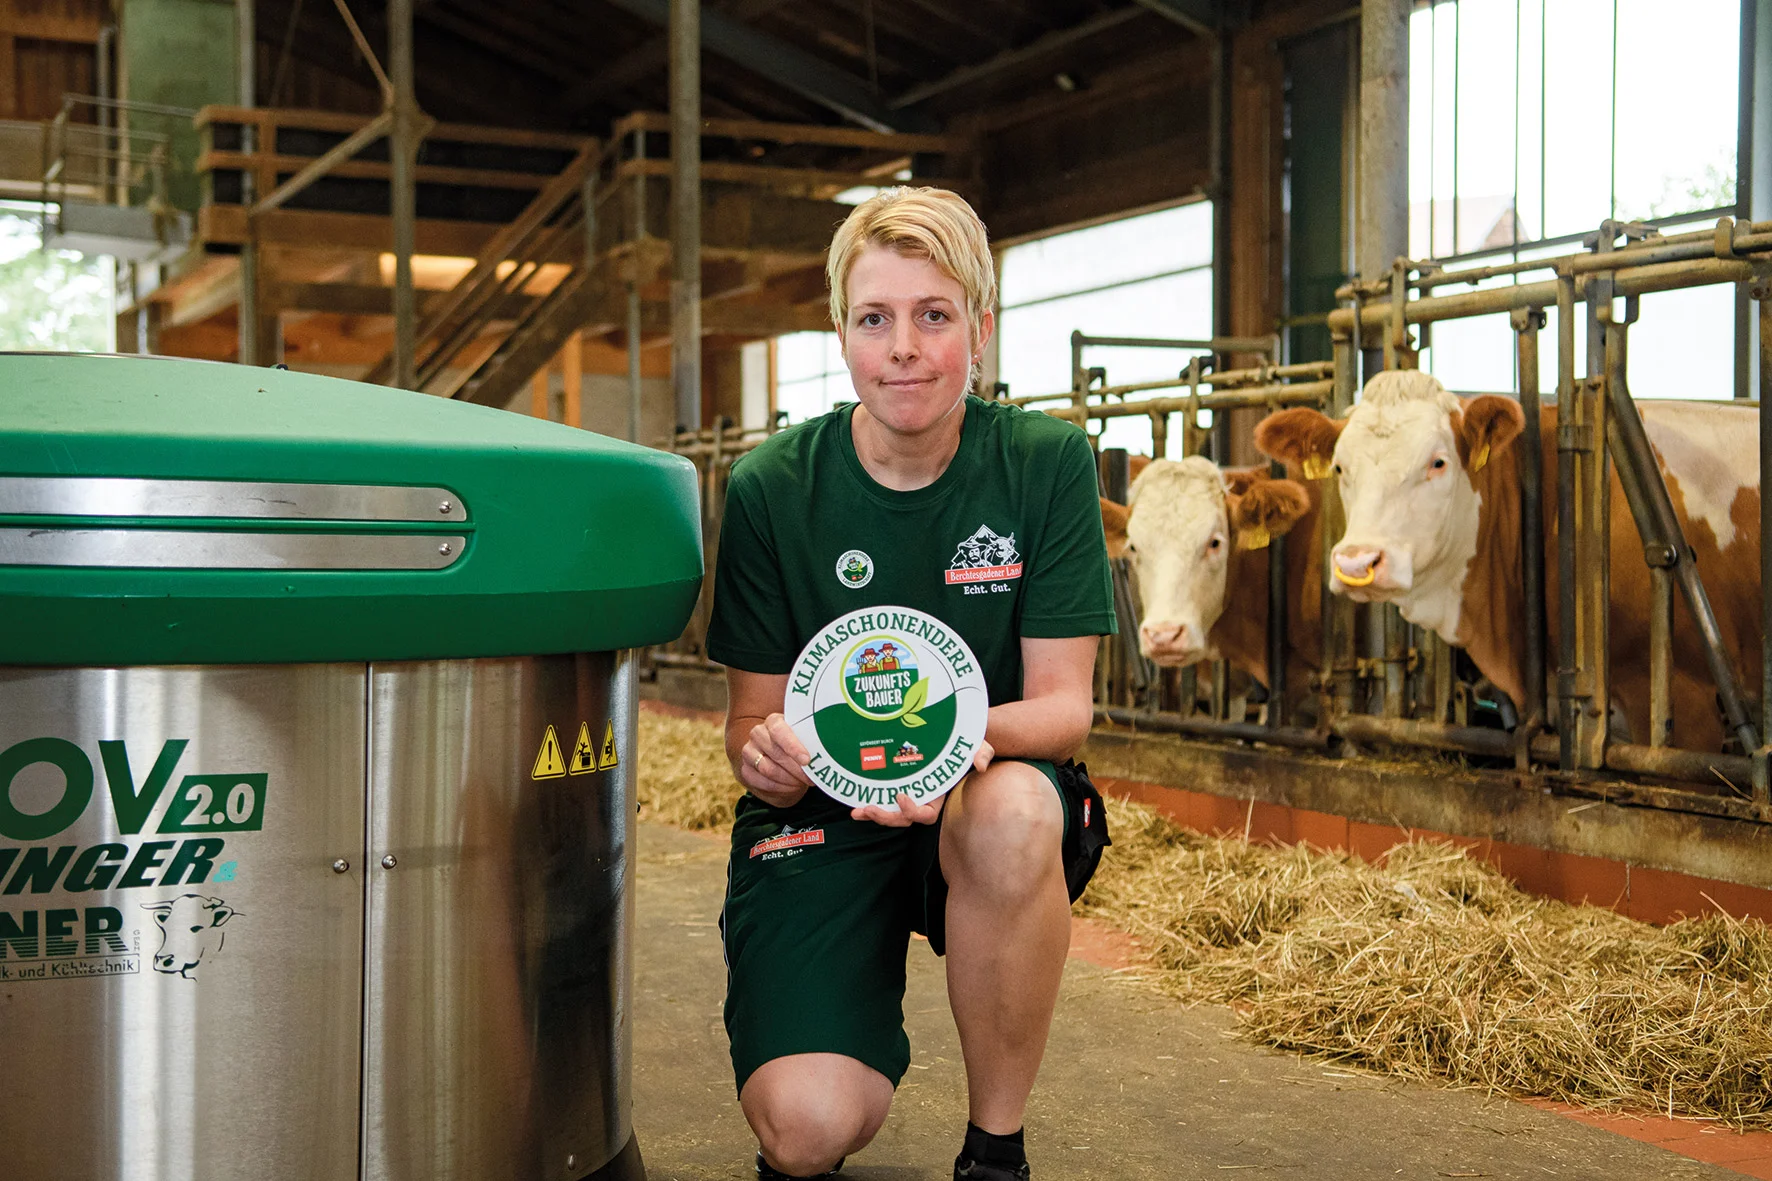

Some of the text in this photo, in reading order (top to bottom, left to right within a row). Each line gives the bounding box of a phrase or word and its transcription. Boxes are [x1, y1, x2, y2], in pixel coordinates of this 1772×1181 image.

[950, 569, 1005, 581] Berchtesgadener
[963, 583, 1011, 595] Echt. Gut.
[791, 612, 974, 696] KLIMASCHONENDERE
[854, 671, 911, 693] ZUKUNFTS
[865, 688, 903, 708] BAUER
[808, 736, 974, 805] LANDWIRTSCHAFT
[181, 783, 256, 826] 2.0
[803, 832, 820, 843] Land
[762, 850, 784, 861] Echt.
[0, 907, 129, 959] NER
[19, 963, 45, 978] und
